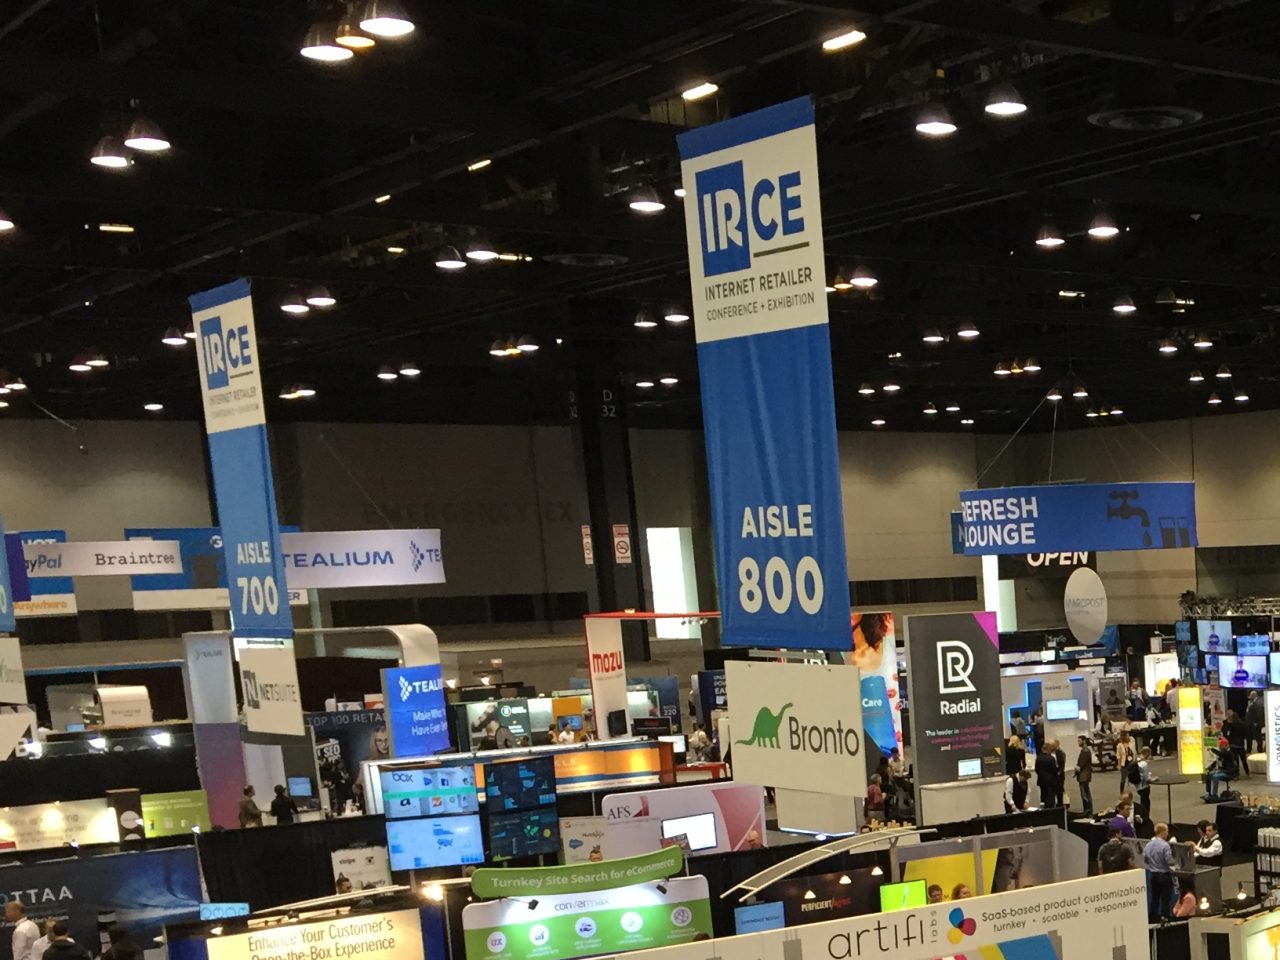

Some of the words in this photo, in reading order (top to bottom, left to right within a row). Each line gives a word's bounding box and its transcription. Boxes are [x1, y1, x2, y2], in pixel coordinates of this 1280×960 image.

[703, 171, 805, 253] IRCE
[705, 277, 756, 302] INTERNET
[759, 267, 812, 292] RETAILER
[707, 301, 758, 321] CONFERENCE
[767, 291, 815, 318] EXHIBITION
[203, 325, 252, 375] IRCE
[741, 504, 814, 538] AISLE
[964, 522, 1036, 547] LOUNGE
[95, 545, 175, 566] Braintree
[237, 541, 272, 564] AISLE
[282, 550, 394, 568] TEALIUM
[237, 575, 279, 616] 700
[738, 555, 824, 614] 800
[592, 651, 623, 674] mozu
[862, 698, 882, 707] Care
[939, 698, 981, 715] Radial
[788, 715, 860, 757] Bronto
[608, 806, 631, 820] AFS
[491, 875, 543, 890] Turnkey
[545, 874, 568, 887] Site
[571, 871, 609, 885] Search
[610, 868, 624, 880] for
[626, 858, 675, 877] eCommerce
[982, 903, 1041, 922] SaaS-based
[1043, 896, 1081, 914] product
[1083, 885, 1146, 904] customization
[993, 919, 1027, 933] turnkey
[1042, 909, 1079, 923] scalable
[1094, 899, 1138, 914] responsive
[300, 928, 325, 944] Your
[328, 917, 394, 940] Customer's
[828, 914, 924, 960] artifi
[929, 910, 937, 943] labs
[335, 937, 396, 959] Experience
